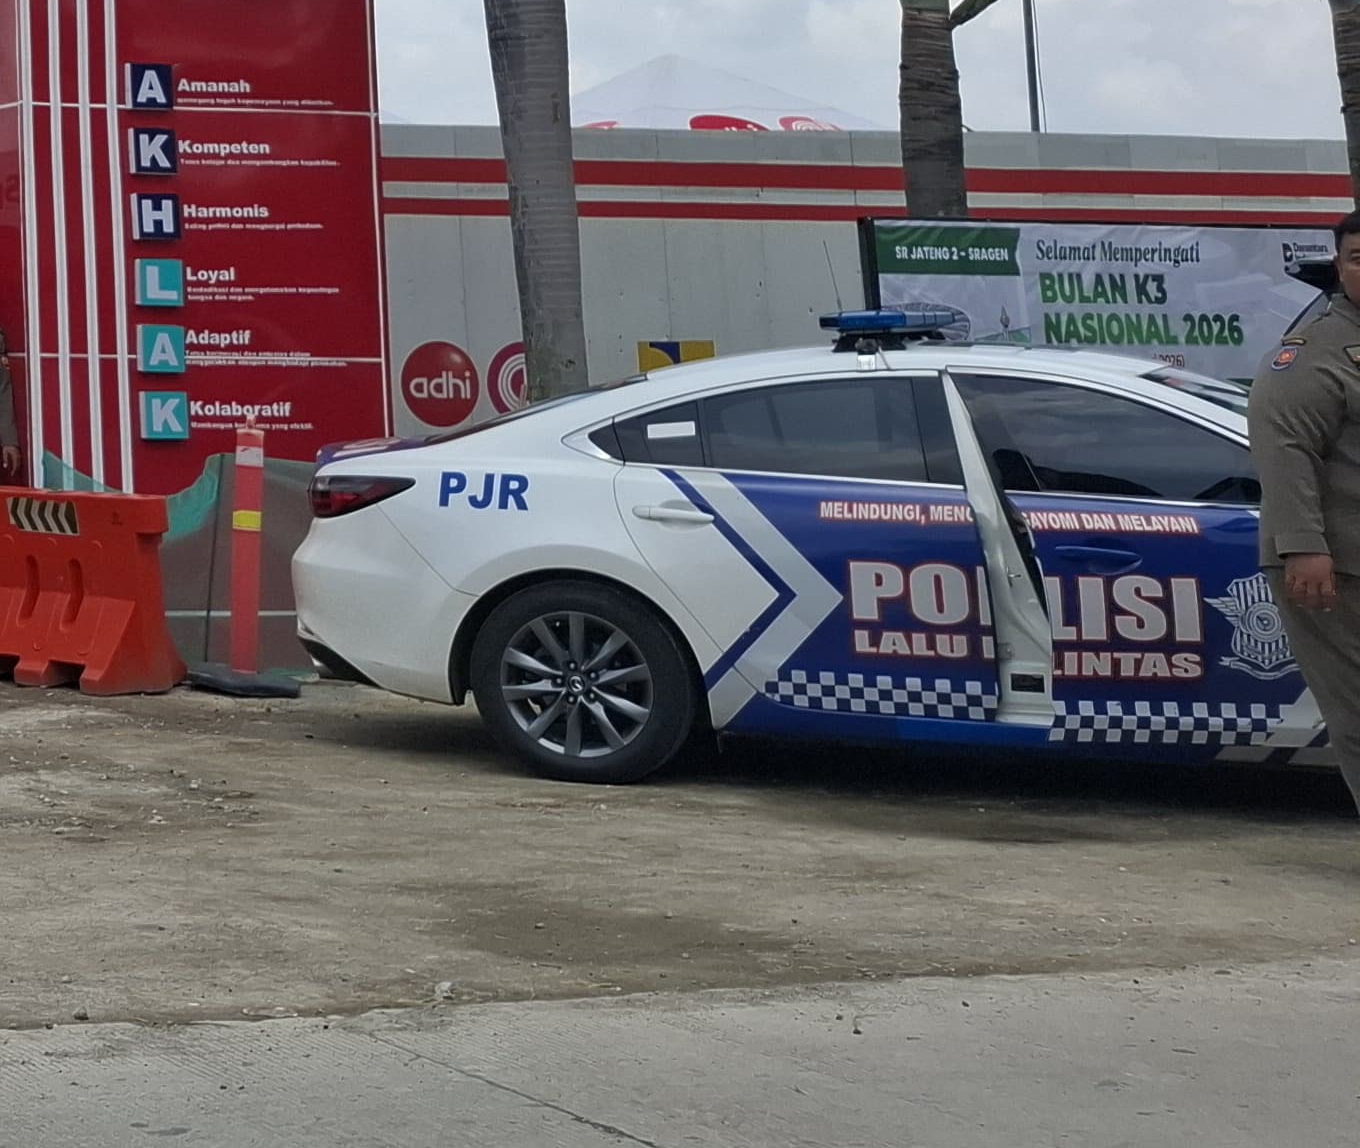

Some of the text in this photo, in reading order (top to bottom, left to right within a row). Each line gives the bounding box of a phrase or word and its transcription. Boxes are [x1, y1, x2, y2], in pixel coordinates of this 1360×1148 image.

[177, 79, 251, 93] Amanah
[178, 139, 270, 156] Kompeten
[183, 204, 269, 218] Harmonis
[895, 246, 908, 259] SR
[909, 246, 949, 260] JATENG
[952, 248, 959, 260] 2
[968, 247, 1008, 261] SRAGEN
[1036, 239, 1200, 268] Selamat Memperingati
[186, 267, 235, 283] Loyal
[1039, 273, 1168, 305] BULAN K3
[185, 329, 251, 347] Adaptif
[1043, 312, 1244, 346] NASIONAL 2026
[410, 371, 471, 399] adhi
[190, 401, 291, 417] Kolaboratif
[439, 471, 529, 511] PJR
[820, 502, 926, 524] MELINDUNGI,
[1081, 513, 1116, 531] DAN
[1119, 515, 1199, 534] MELAYANI
[855, 630, 968, 658] LALU
